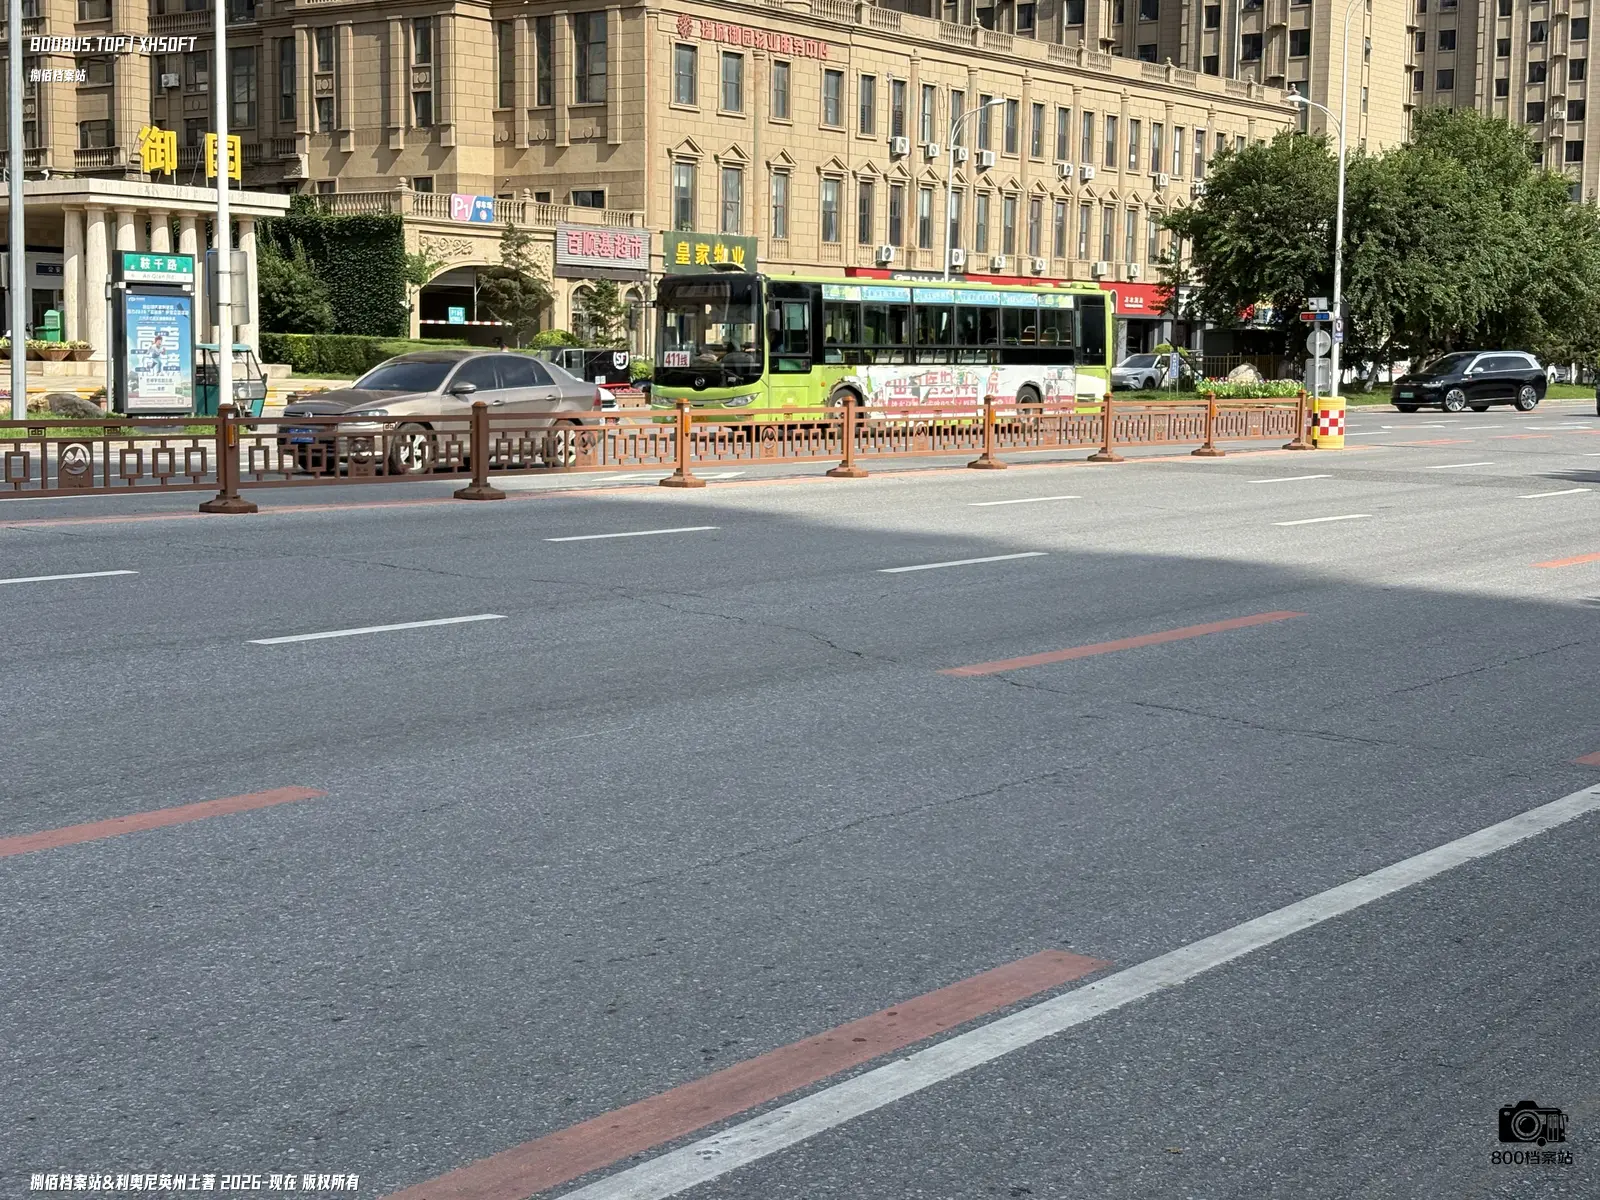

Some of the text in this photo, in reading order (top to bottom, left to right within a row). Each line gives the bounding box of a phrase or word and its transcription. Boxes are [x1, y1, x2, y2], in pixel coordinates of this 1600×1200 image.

[454, 197, 469, 218] P1
[675, 241, 746, 266] 皇家物业
[140, 256, 177, 271] 鞍千路
[616, 352, 626, 364] SF
[665, 353, 688, 366] 411线
